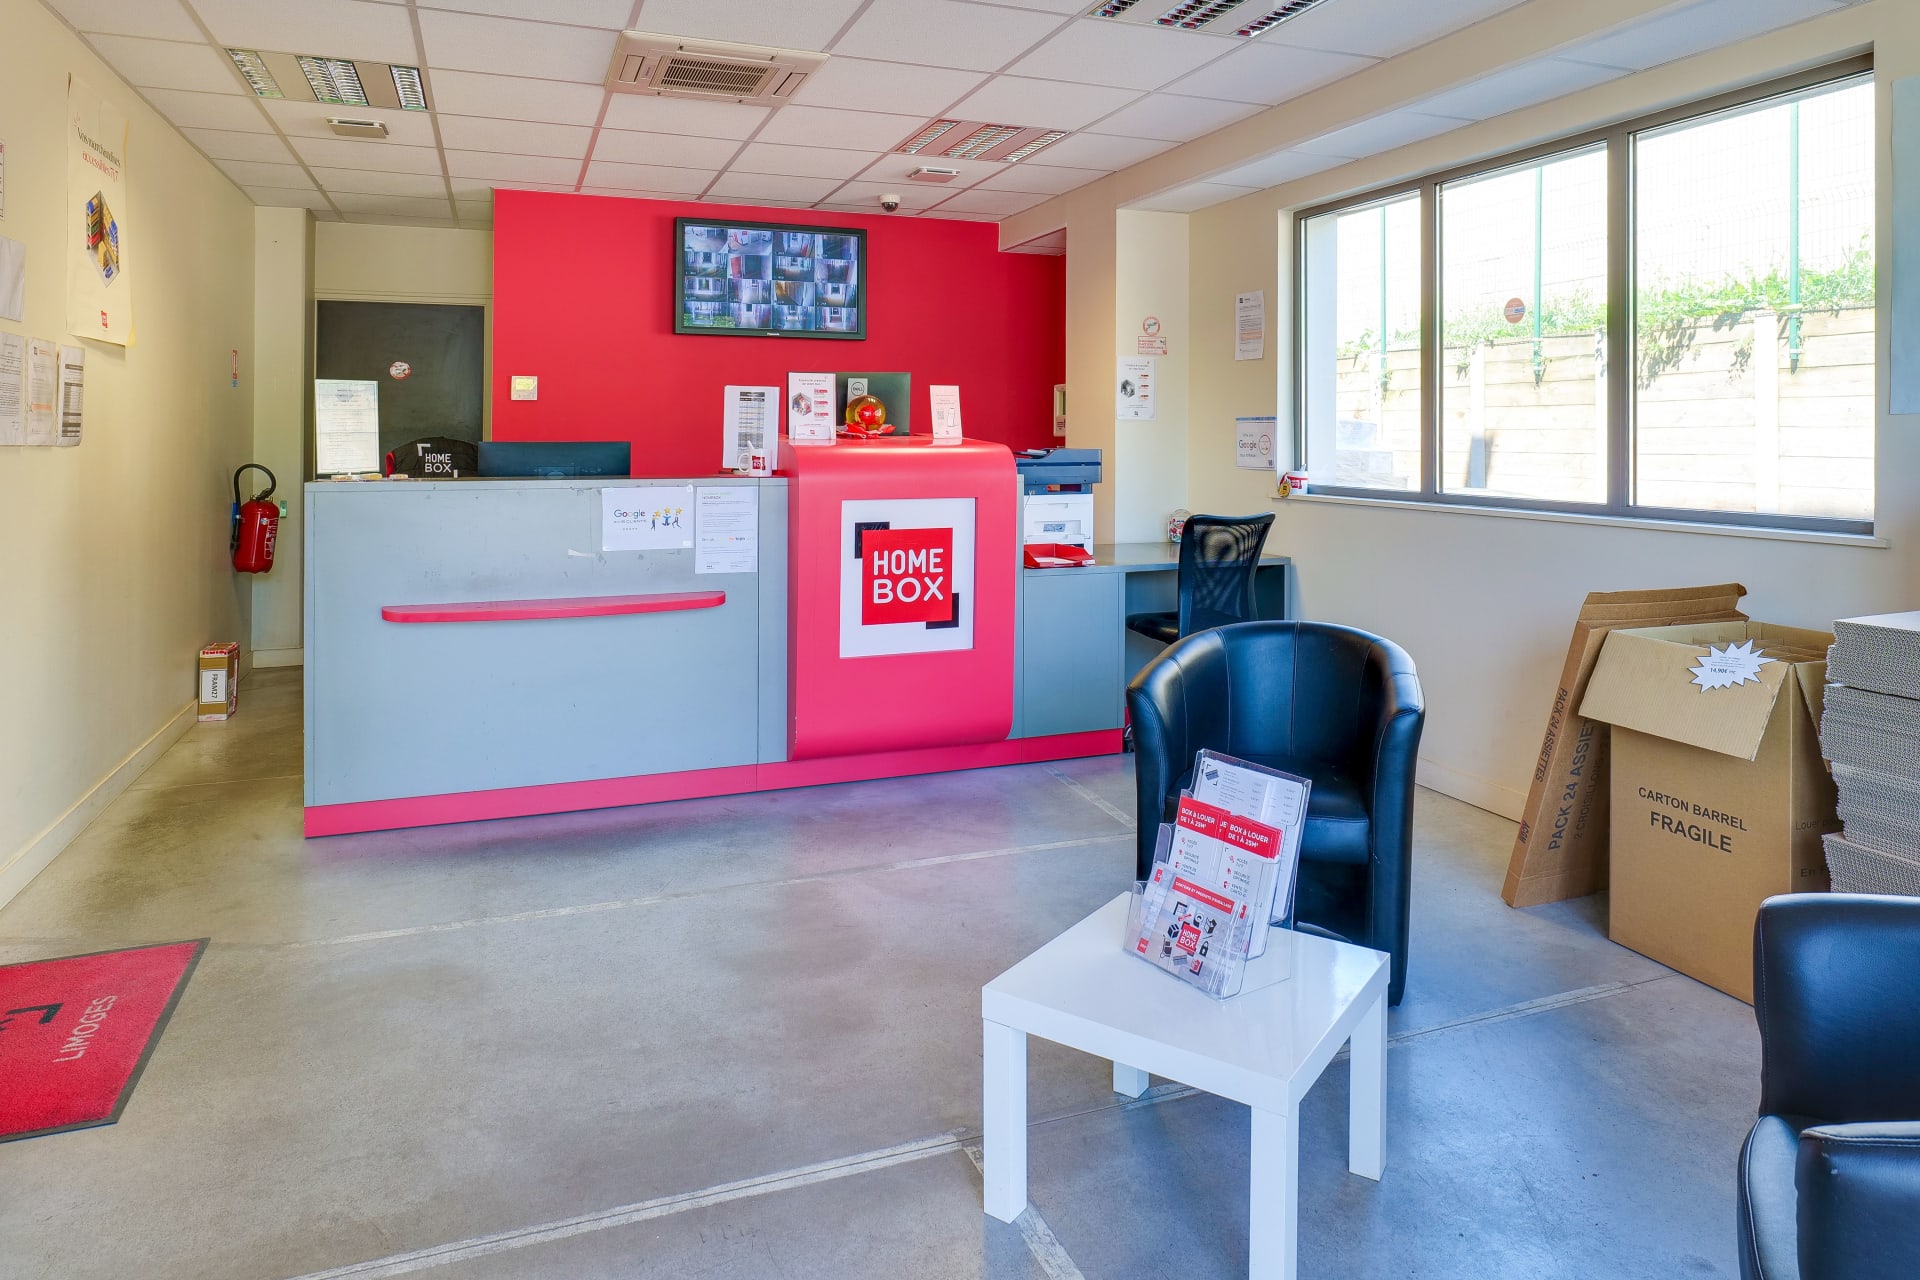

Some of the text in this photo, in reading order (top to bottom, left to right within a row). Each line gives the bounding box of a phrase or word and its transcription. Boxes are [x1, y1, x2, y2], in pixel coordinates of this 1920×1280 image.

[1238, 440, 1256, 451] Google
[424, 453, 452, 462] HOME
[424, 463, 452, 472] BOX
[614, 508, 646, 520] Google
[873, 548, 944, 576] HOME
[873, 576, 944, 604] BOX
[1535, 688, 1568, 783] PACK 24 ASSIETTES
[1181, 807, 1192, 816] BOX
[1196, 812, 1216, 824] LOUER
[1548, 804, 1573, 851] PACK
[1562, 782, 1579, 802] 24
[1638, 786, 1748, 832] CARTON BARREL
[1227, 832, 1236, 840] DE
[1229, 824, 1242, 834] BOX
[1247, 831, 1269, 844] LOUER
[1650, 810, 1732, 854] FRAGILE
[1180, 936, 1196, 948] BOX
[1182, 930, 1198, 942] HOME
[52, 995, 118, 1063] LIMOGES
